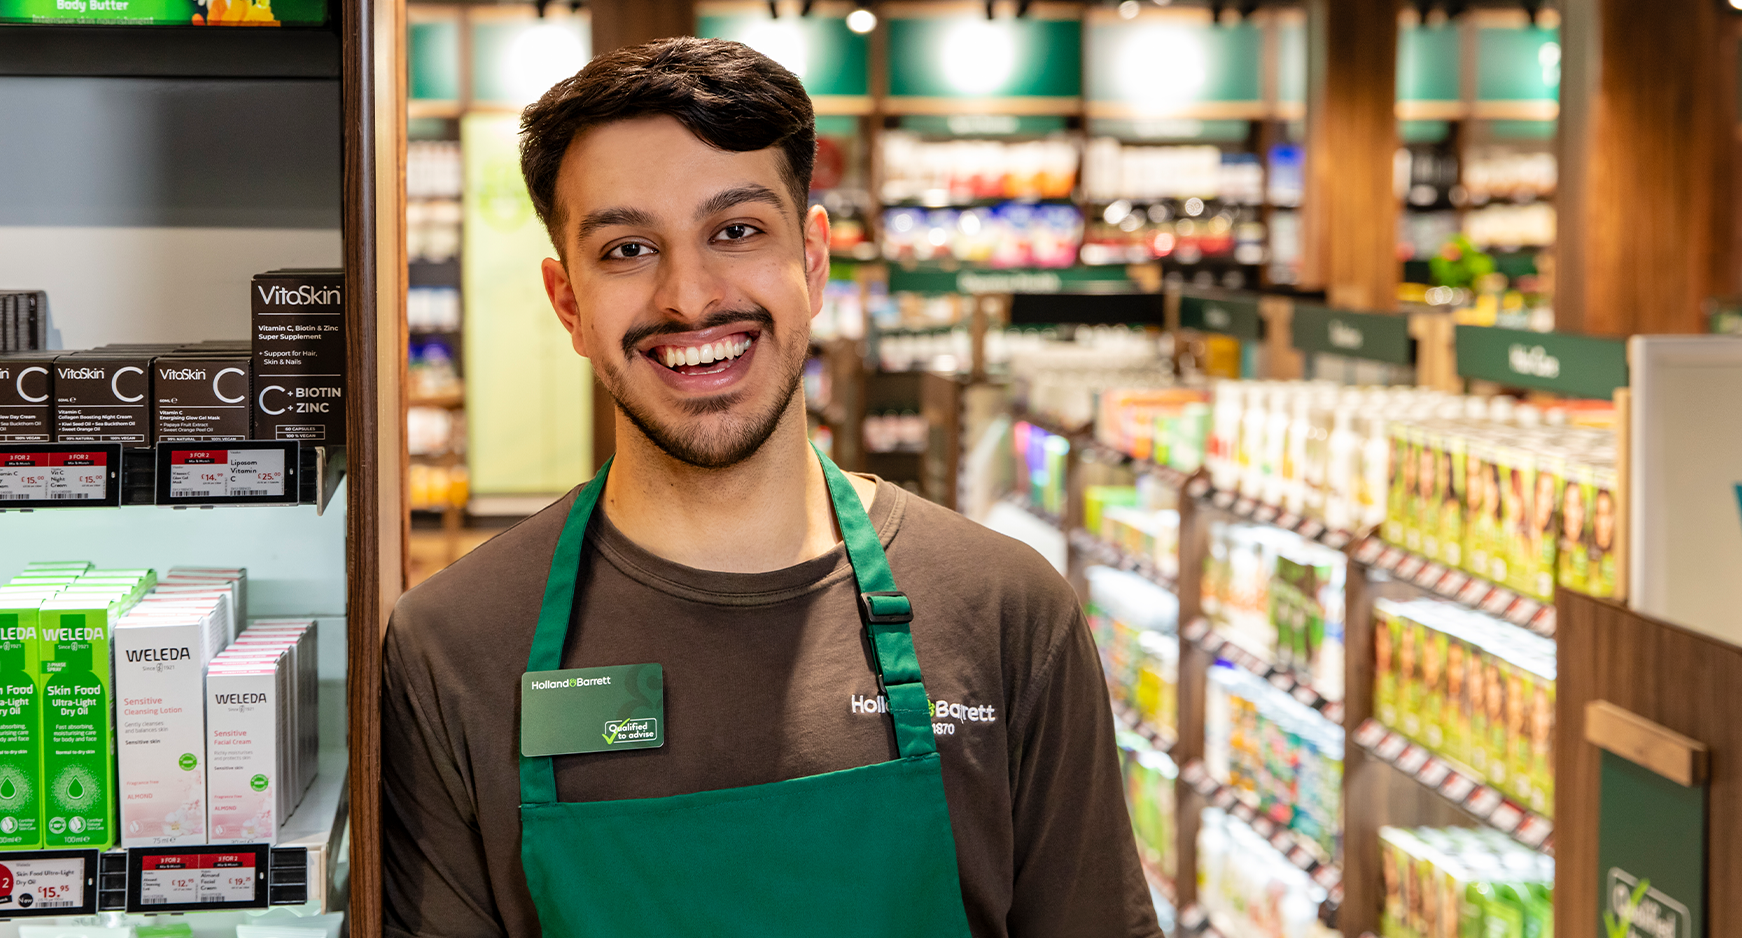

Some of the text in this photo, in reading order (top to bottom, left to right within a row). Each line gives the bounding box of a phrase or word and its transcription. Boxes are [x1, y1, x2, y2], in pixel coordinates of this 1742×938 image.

[57, 0, 129, 13] Body Butter
[16, 366, 49, 403] C
[111, 366, 144, 403] C
[213, 367, 245, 404] C
[295, 387, 341, 398] BIOTIN
[258, 385, 286, 416] C
[296, 402, 330, 413] ZINC
[230, 459, 258, 467] Liposom
[42, 627, 104, 641] WELEDA
[126, 647, 191, 663] WELEDA
[6, 684, 34, 695] Food
[47, 684, 101, 696] Skin Food
[52, 698, 97, 707] Ultra-Light
[124, 697, 163, 706] Sensitive
[215, 693, 267, 705] WELEDA
[60, 707, 89, 717] Dry Oil
[124, 706, 183, 716] Cleansing Lotion
[124, 721, 142, 729] Gently
[608, 722, 648, 733] Qualified
[214, 730, 247, 738] Sensitive
[127, 792, 153, 800] ALMOND
[2, 877, 10, 889] 2
[37, 885, 70, 898] £15.95
